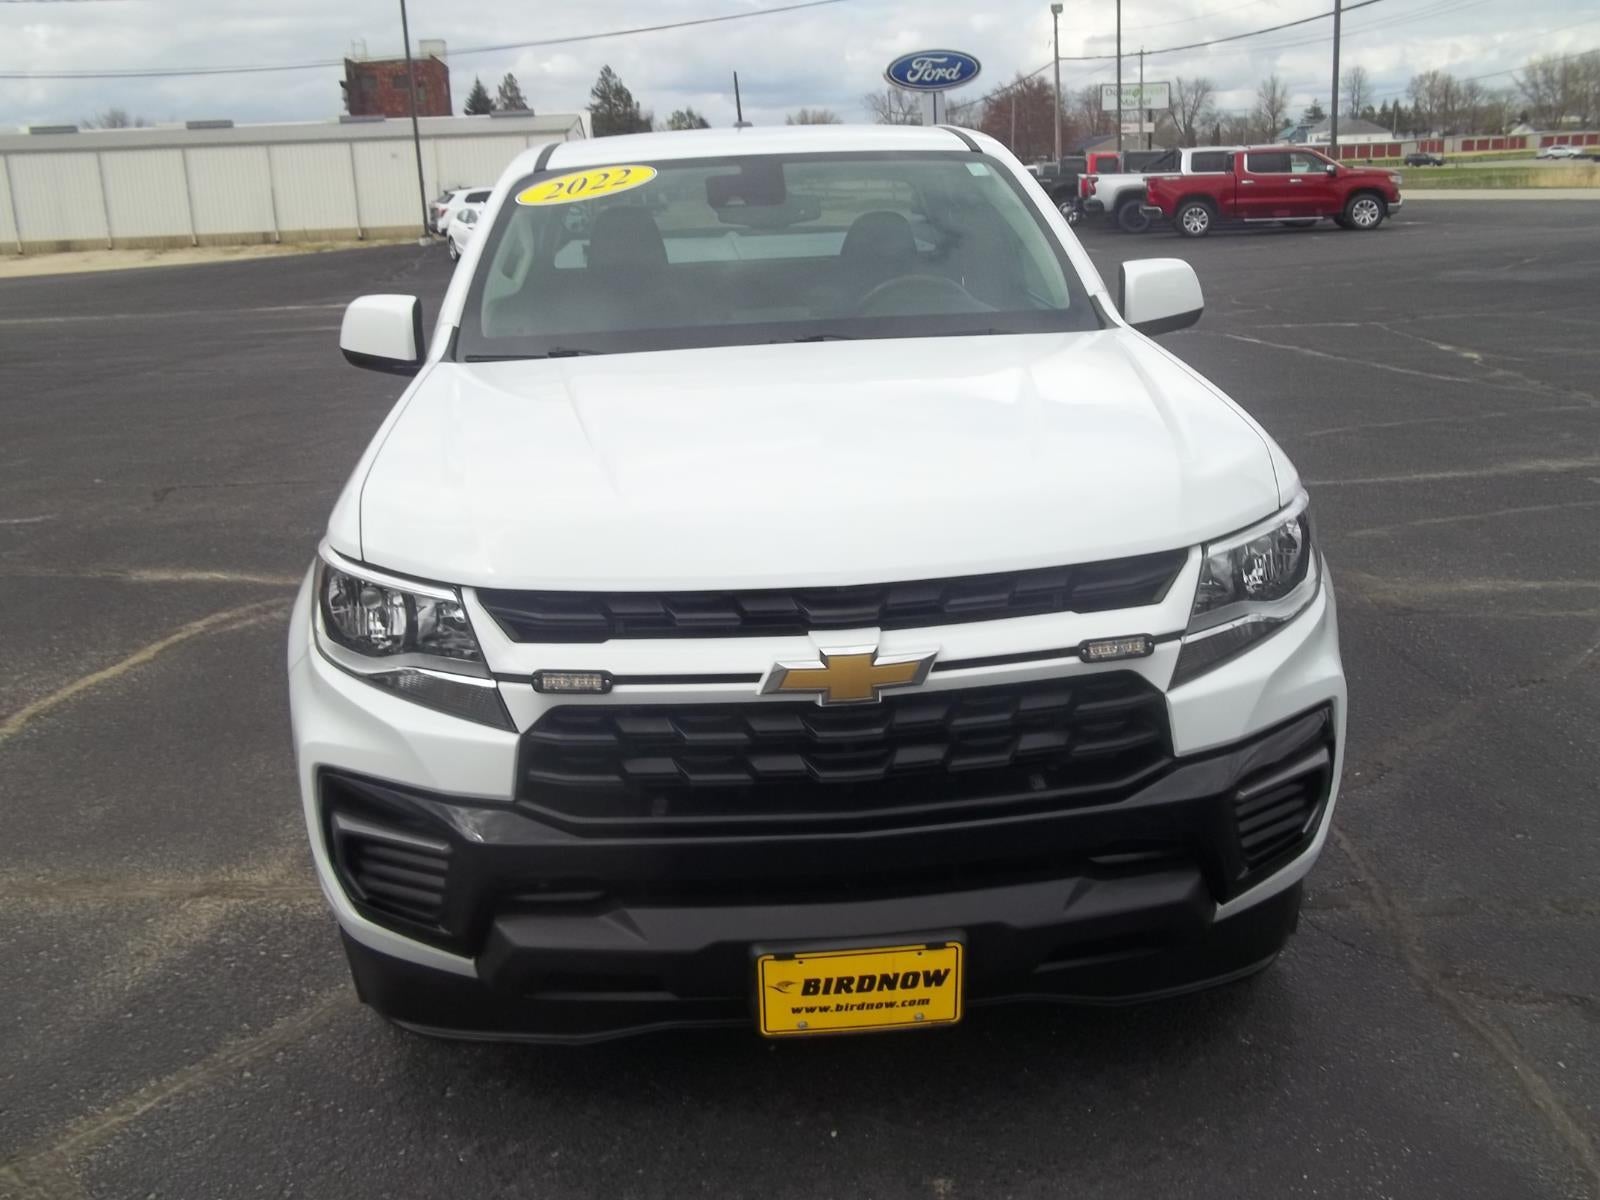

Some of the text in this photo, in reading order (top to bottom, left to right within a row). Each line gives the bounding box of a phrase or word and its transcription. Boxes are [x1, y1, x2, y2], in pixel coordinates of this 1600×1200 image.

[906, 57, 962, 82] Ford
[1105, 87, 1132, 97] Dolar
[544, 168, 632, 200] 2022
[800, 968, 951, 996] BIRDNOW
[791, 998, 931, 1015] www.birdnow.com
